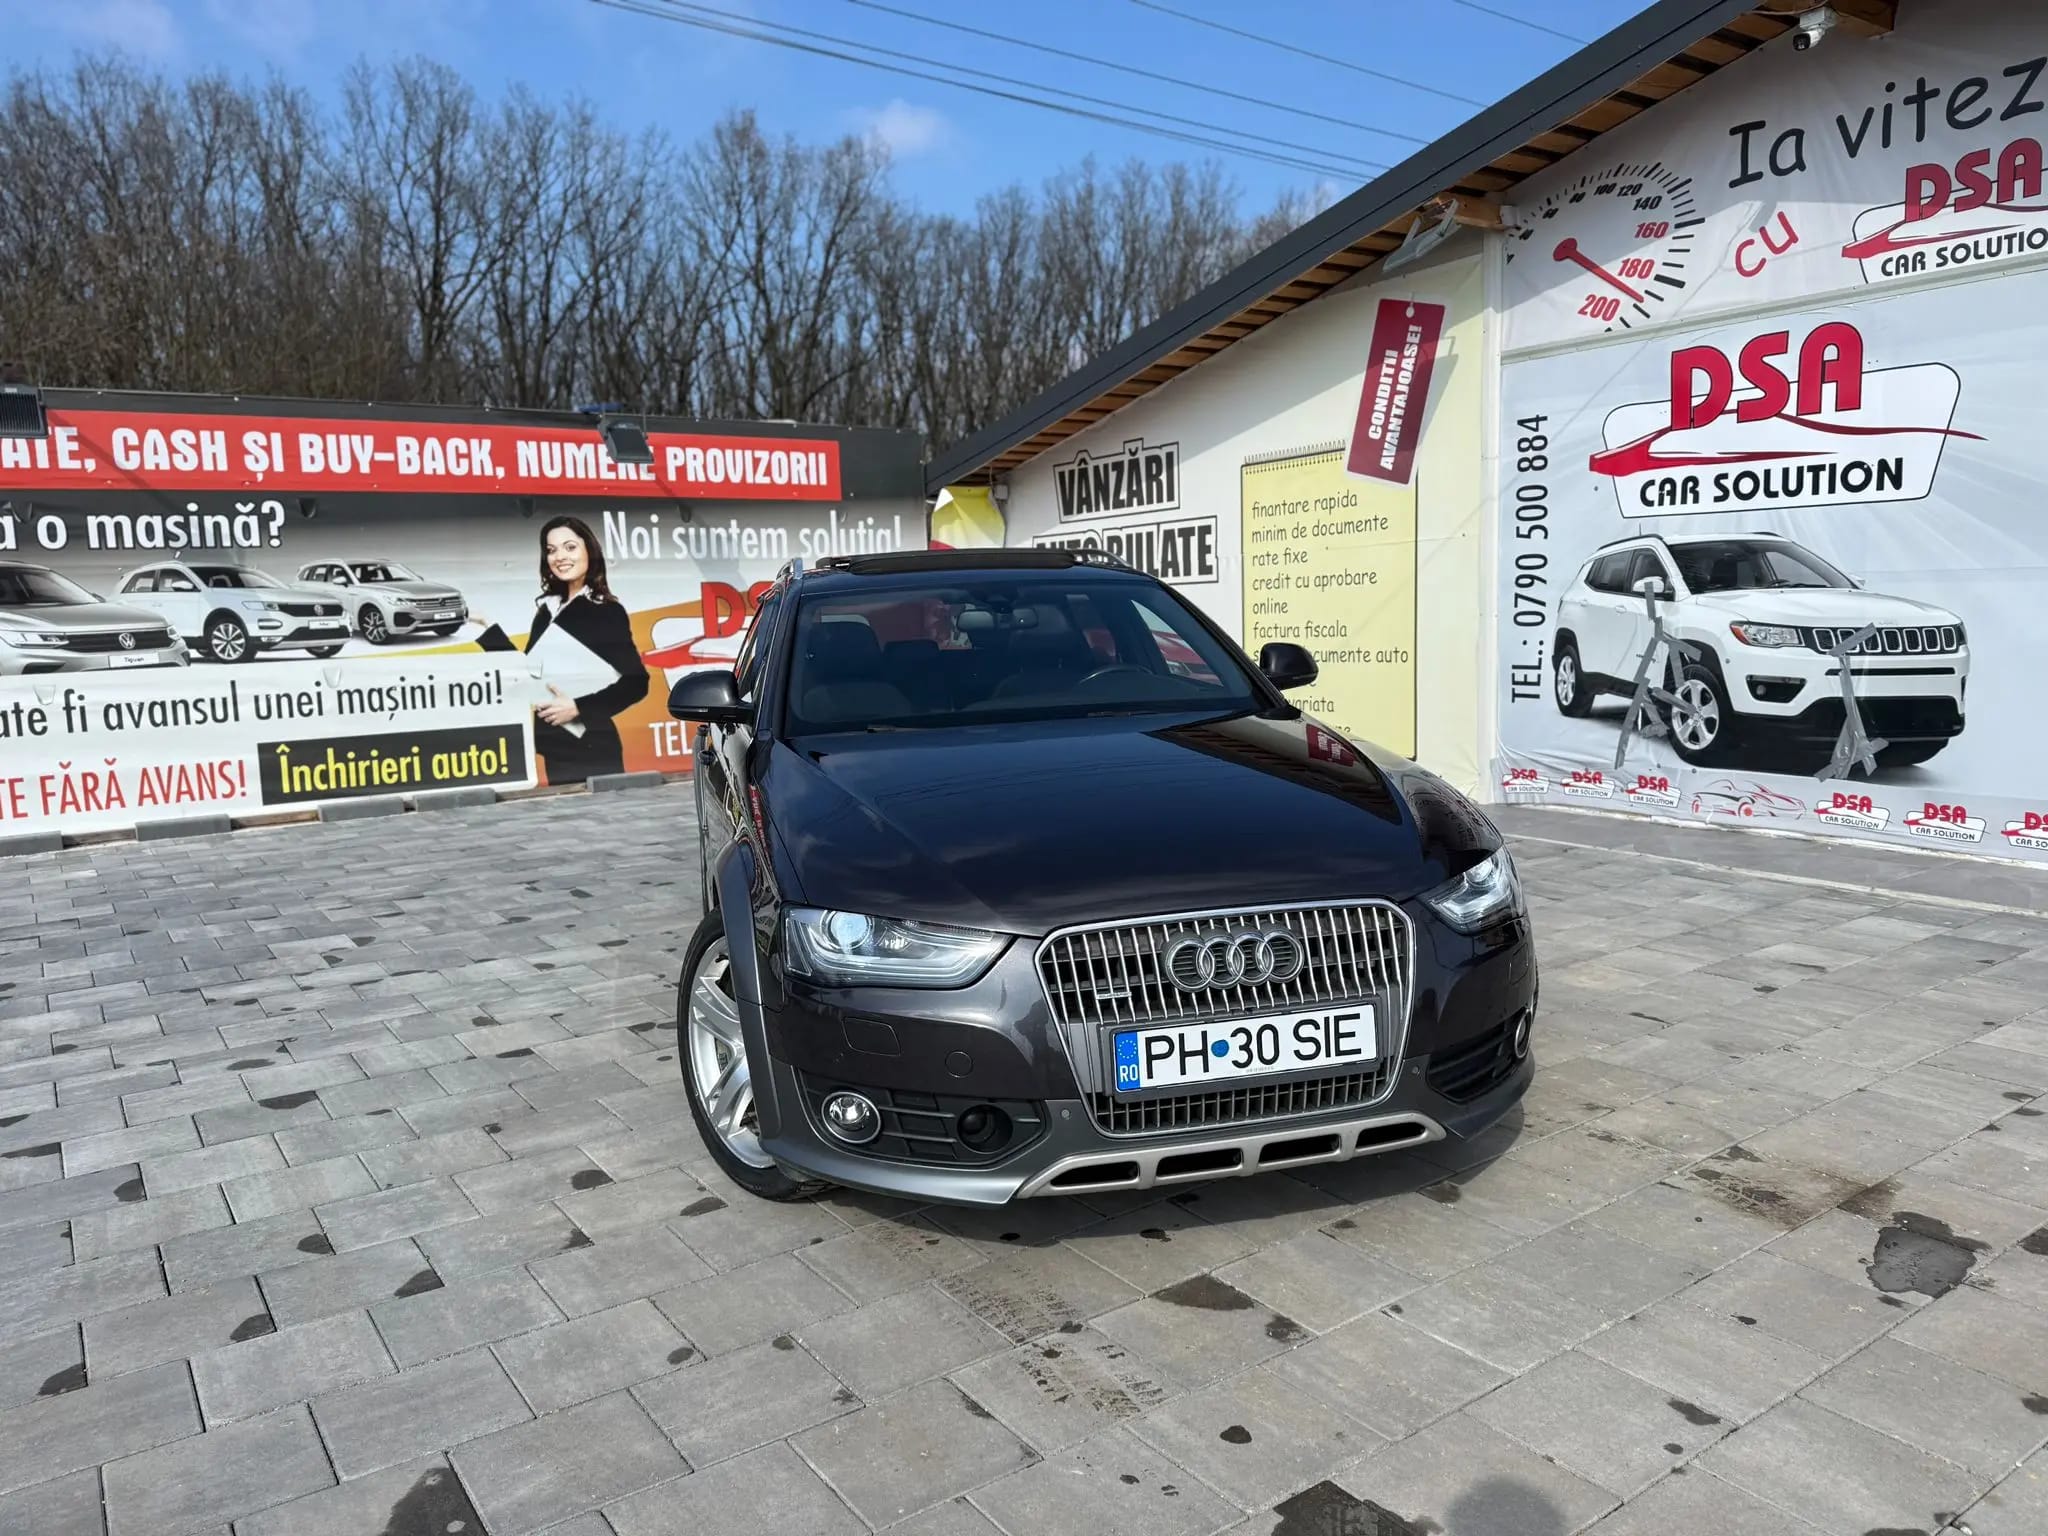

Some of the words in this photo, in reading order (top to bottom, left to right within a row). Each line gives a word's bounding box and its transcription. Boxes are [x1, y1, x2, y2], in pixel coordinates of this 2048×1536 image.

[1729, 120, 1806, 188] Ia
[1836, 56, 2048, 159] vitez
[1593, 182, 1618, 196] 100
[1617, 183, 1643, 197] 120
[1905, 137, 2043, 223] DSA
[1633, 195, 1662, 211] 140
[1634, 221, 1669, 239] 160
[1735, 211, 1799, 278] cu
[1617, 258, 1655, 279] 180
[1881, 251, 1926, 277] CAR
[1577, 294, 1621, 321] 200
[1671, 321, 1864, 431] DSA
[1368, 349, 1399, 440] CONDITII
[1380, 324, 1422, 471] AVANTAJOASE!
[1517, 414, 1548, 472] 884
[111, 428, 228, 471] CASH
[242, 431, 285, 482] ȘI
[666, 446, 827, 486] PROVIZORII
[1058, 446, 1176, 516] VÂNZĂRI
[1640, 475, 1700, 507] CAR
[1713, 457, 1903, 503] SOLUTION
[1252, 499, 1310, 520] finantare
[1314, 489, 1357, 515] rapida
[1516, 484, 1548, 539] 500
[37, 515, 68, 550] o
[602, 510, 661, 561] Noi
[672, 518, 788, 561] suntem
[1252, 525, 1287, 543] minim
[1291, 521, 1308, 539] de
[1312, 514, 1389, 537] documente
[1252, 551, 1279, 566] rate
[1284, 547, 1309, 566] fixe
[1252, 573, 1291, 591] credit
[1295, 575, 1310, 589] cu
[1314, 568, 1377, 592] aprobare
[1513, 553, 1548, 627] 0790
[1252, 597, 1288, 615] online
[1253, 622, 1300, 639] factura
[1305, 620, 1347, 639] fiscala
[1312, 647, 1372, 663] cumente
[1376, 647, 1409, 663] auto
[1511, 639, 1544, 704] TEL.:
[62, 688, 88, 733] fi
[103, 680, 240, 731] avansul
[254, 681, 323, 720] unei
[337, 675, 436, 720] mașini
[449, 670, 502, 707] noi!
[276, 744, 422, 794] Închirieri
[432, 737, 508, 779] auto!
[1510, 768, 1538, 781] DSA
[1571, 770, 1603, 785] DSA
[40, 758, 126, 816] FĂRĂ
[138, 760, 247, 807] AVANS!
[1581, 789, 1609, 798] SOLUTION
[1637, 774, 1668, 791] DSA
[1645, 796, 1675, 806] SOLUTION
[1832, 792, 1873, 813] DSA
[1924, 802, 1967, 824] DSA
[1841, 816, 1880, 829] SOLUTION
[1915, 827, 1932, 835] CAR
[1933, 828, 1975, 841] SOLUTION
[2015, 838, 2032, 846] CAR
[1145, 1030, 1210, 1080] PH
[1230, 1023, 1280, 1069] 30
[1292, 1013, 1363, 1061] SIE
[1119, 1063, 1139, 1083] RO
